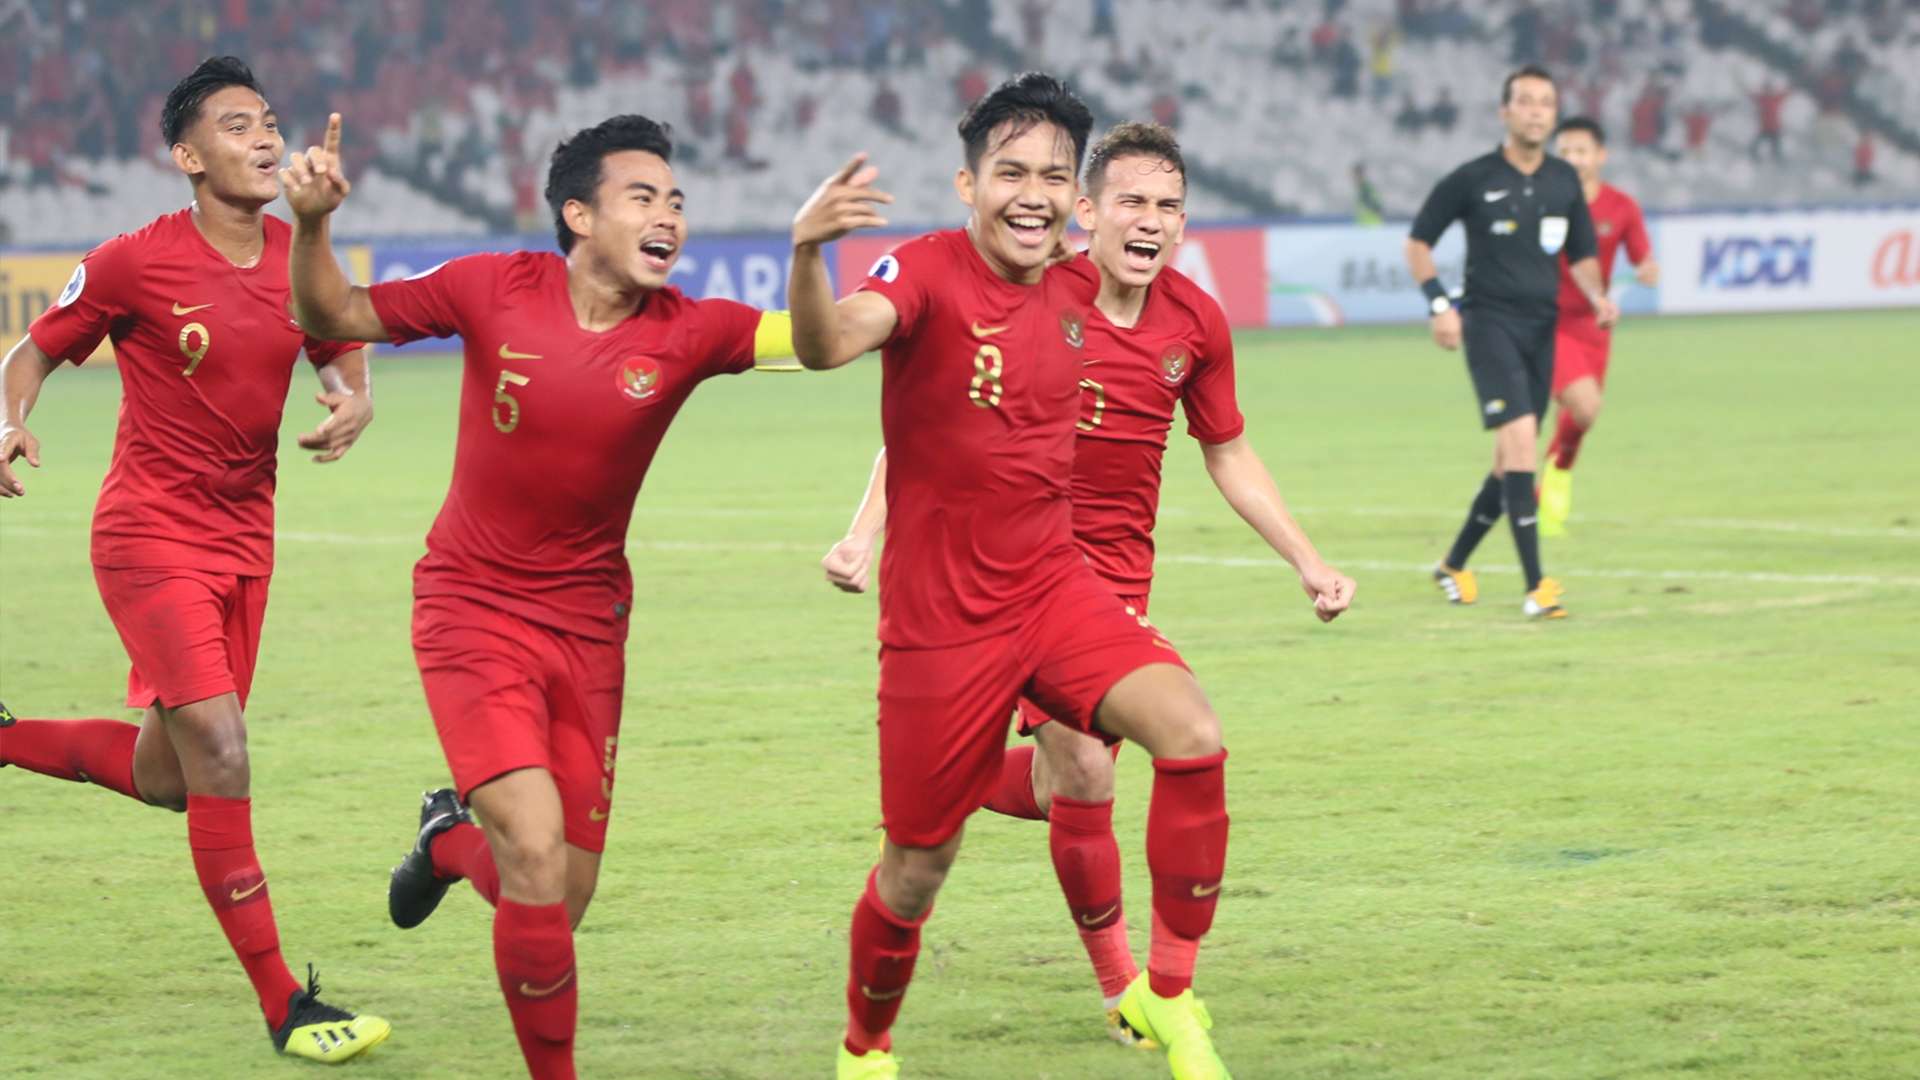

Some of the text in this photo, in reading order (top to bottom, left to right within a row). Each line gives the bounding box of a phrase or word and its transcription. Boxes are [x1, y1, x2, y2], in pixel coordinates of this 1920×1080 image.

[1700, 236, 1814, 289] KDDI
[178, 321, 210, 377] 9
[968, 344, 1003, 408] 8
[491, 369, 531, 434] 5
